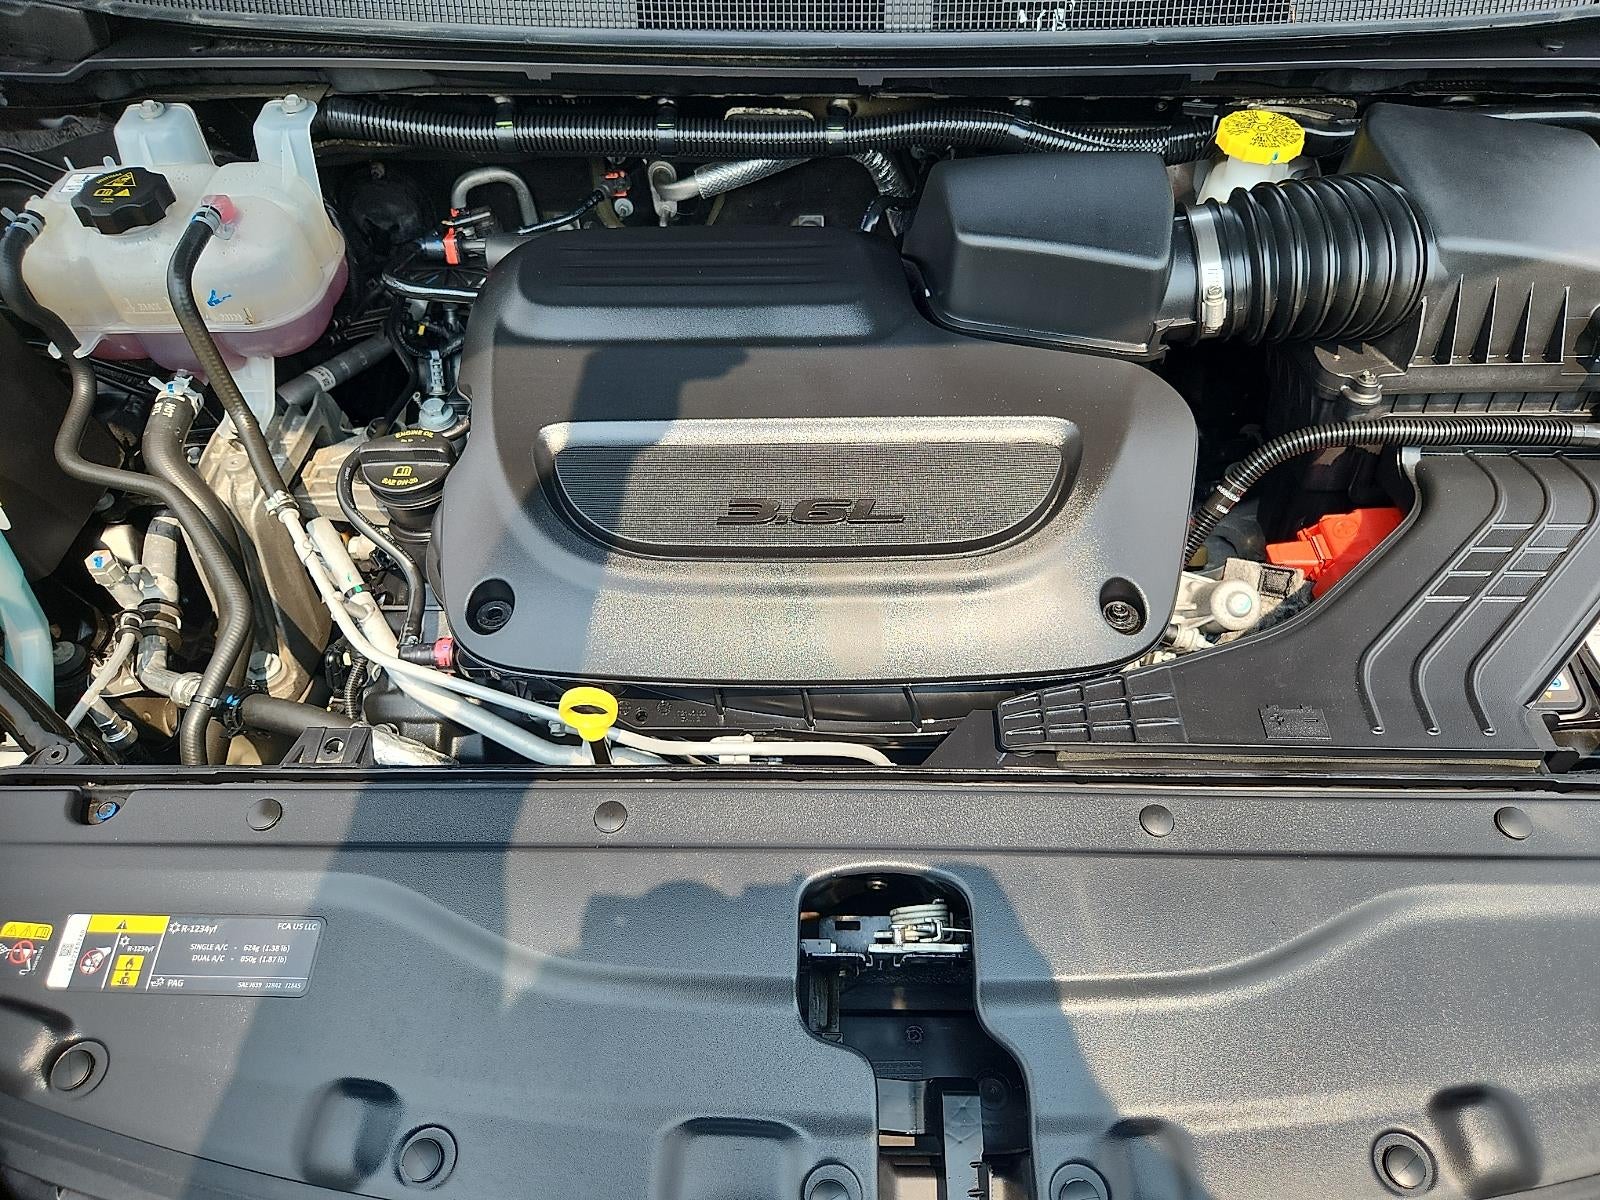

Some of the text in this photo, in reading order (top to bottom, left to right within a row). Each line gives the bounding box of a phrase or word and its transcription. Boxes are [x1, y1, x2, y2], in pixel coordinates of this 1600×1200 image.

[395, 430, 434, 439] ENGINE OIL
[716, 498, 904, 525] 3.6L
[181, 924, 218, 934] R-1234yf
[277, 922, 318, 931] FCA US LLC
[127, 945, 155, 953] R-1234yf
[189, 943, 214, 951] SINGLE
[214, 943, 228, 952] A/C
[243, 944, 260, 953] 624g
[280, 945, 291, 953] lb)
[191, 954, 211, 962] DUAL
[210, 954, 226, 963] A/C
[240, 955, 257, 964] 850g
[277, 955, 288, 964] lb)
[167, 979, 184, 988] PAG
